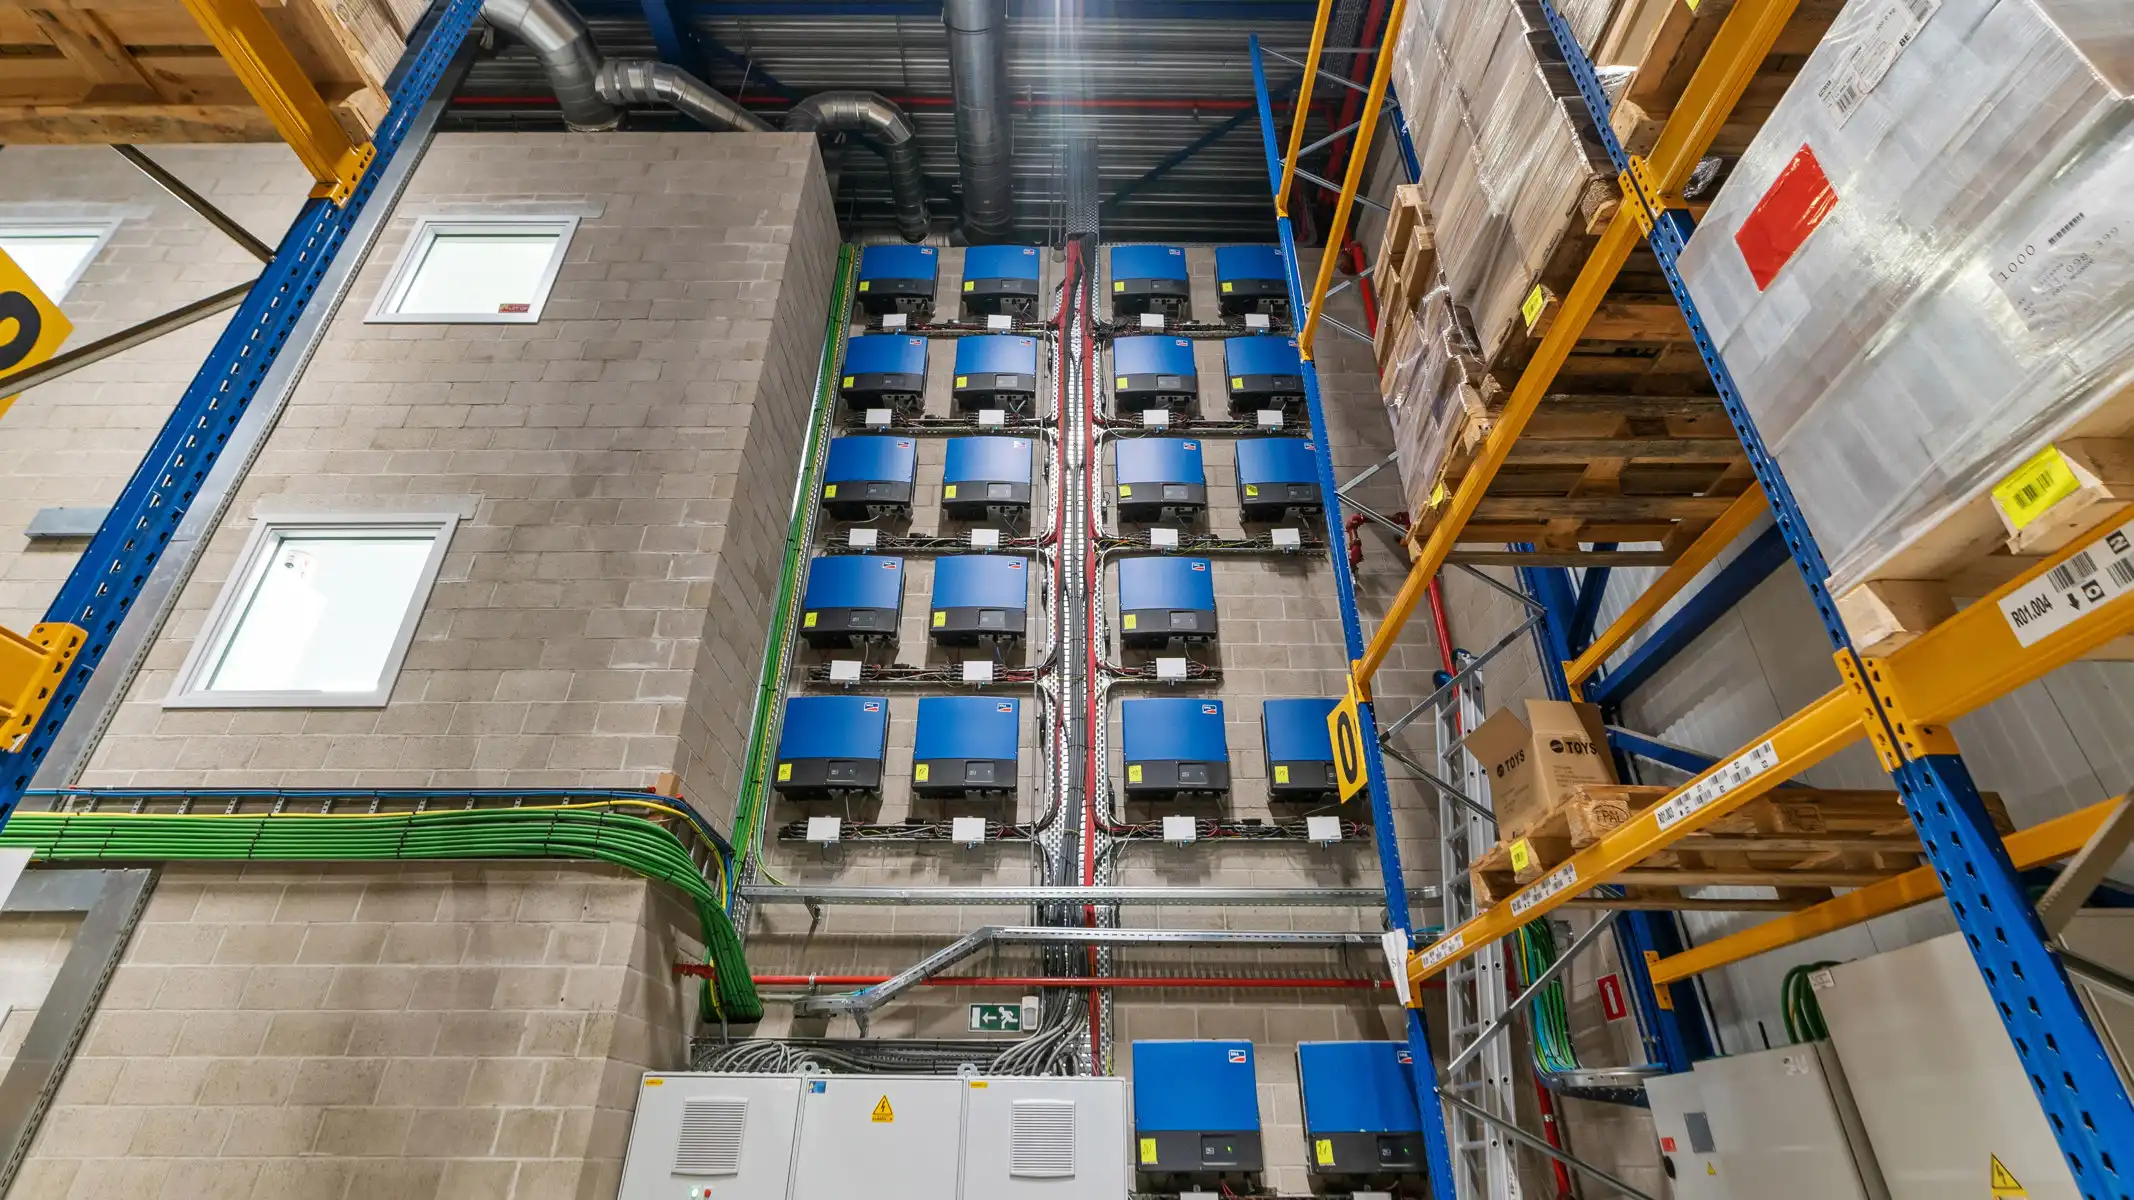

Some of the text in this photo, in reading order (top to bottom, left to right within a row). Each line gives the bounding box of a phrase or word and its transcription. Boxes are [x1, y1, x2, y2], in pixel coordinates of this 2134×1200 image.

[1998, 244, 2036, 281] 1000
[2010, 593, 2053, 629] R01.004
[1337, 711, 1358, 784] 0
[1504, 749, 1525, 772] TOYS
[1565, 741, 1597, 755] TOYS
